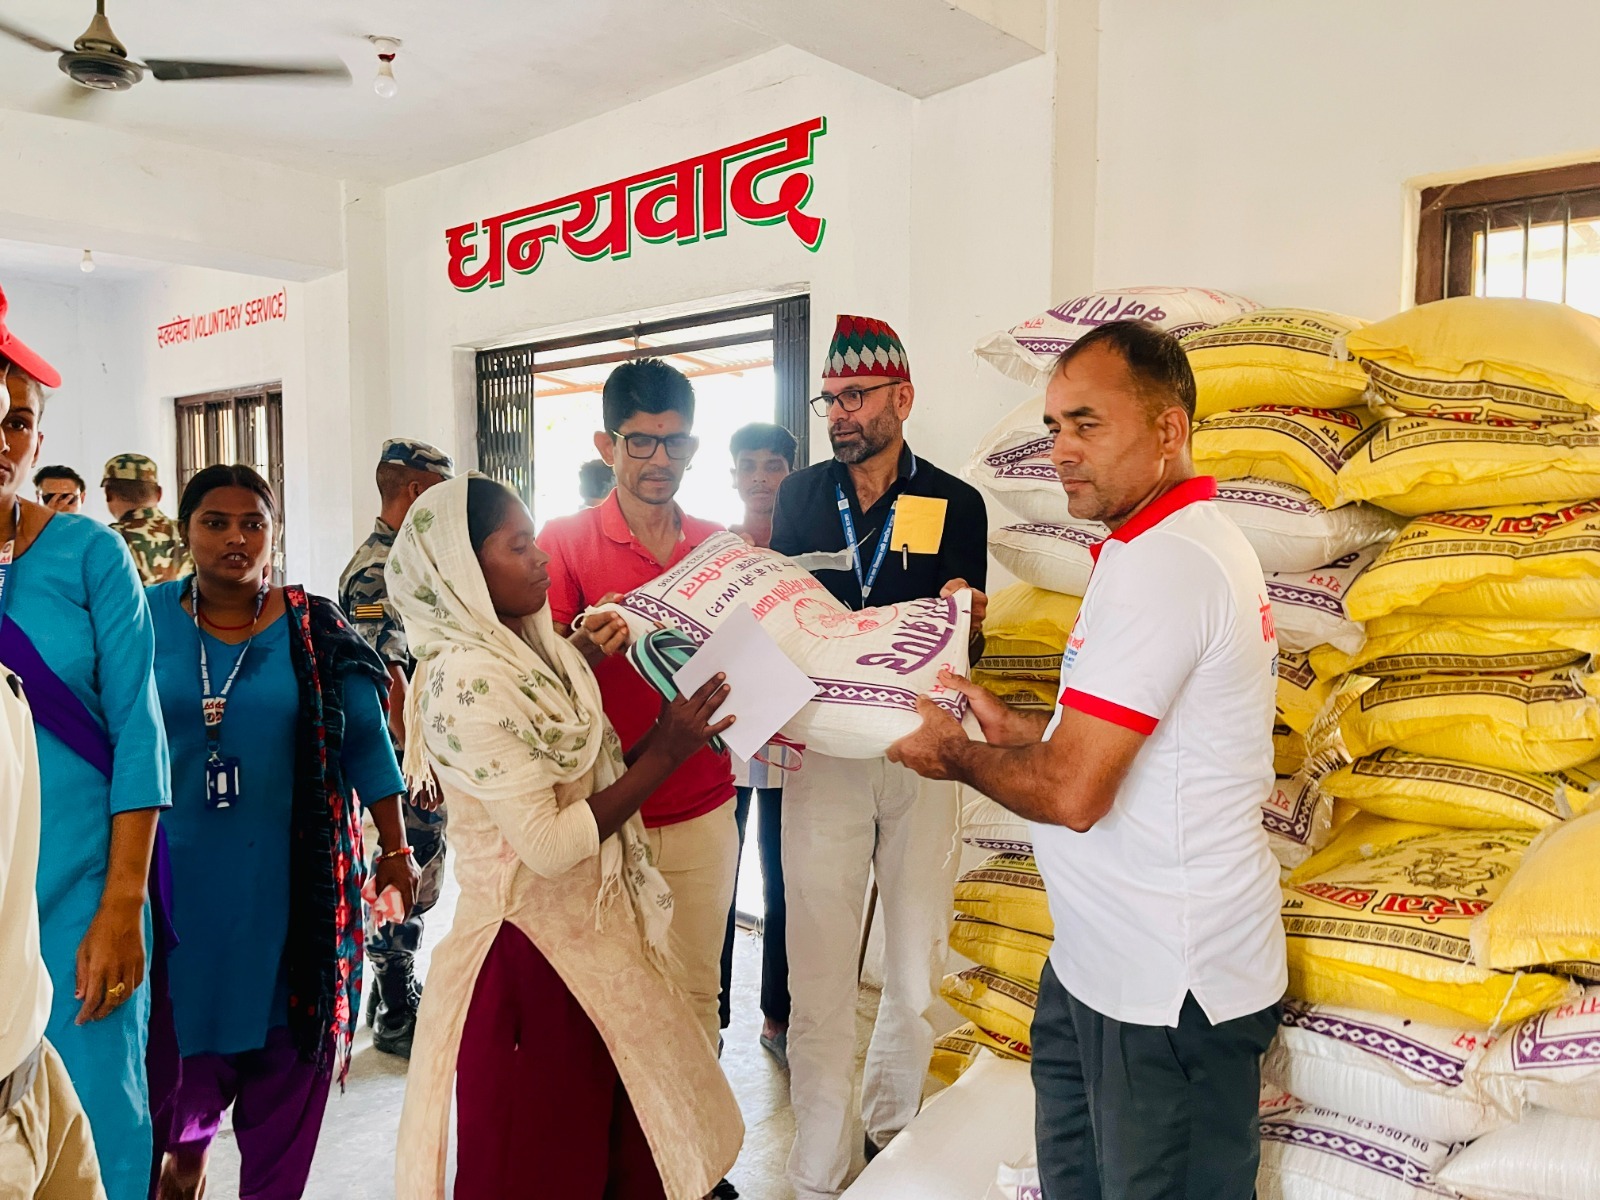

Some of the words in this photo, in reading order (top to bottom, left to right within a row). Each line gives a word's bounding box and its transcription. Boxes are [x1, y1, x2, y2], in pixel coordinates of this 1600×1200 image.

[446, 116, 827, 293] धन्यवाद
[245, 286, 287, 326] SERVICE)
[751, 593, 782, 623] चाम
